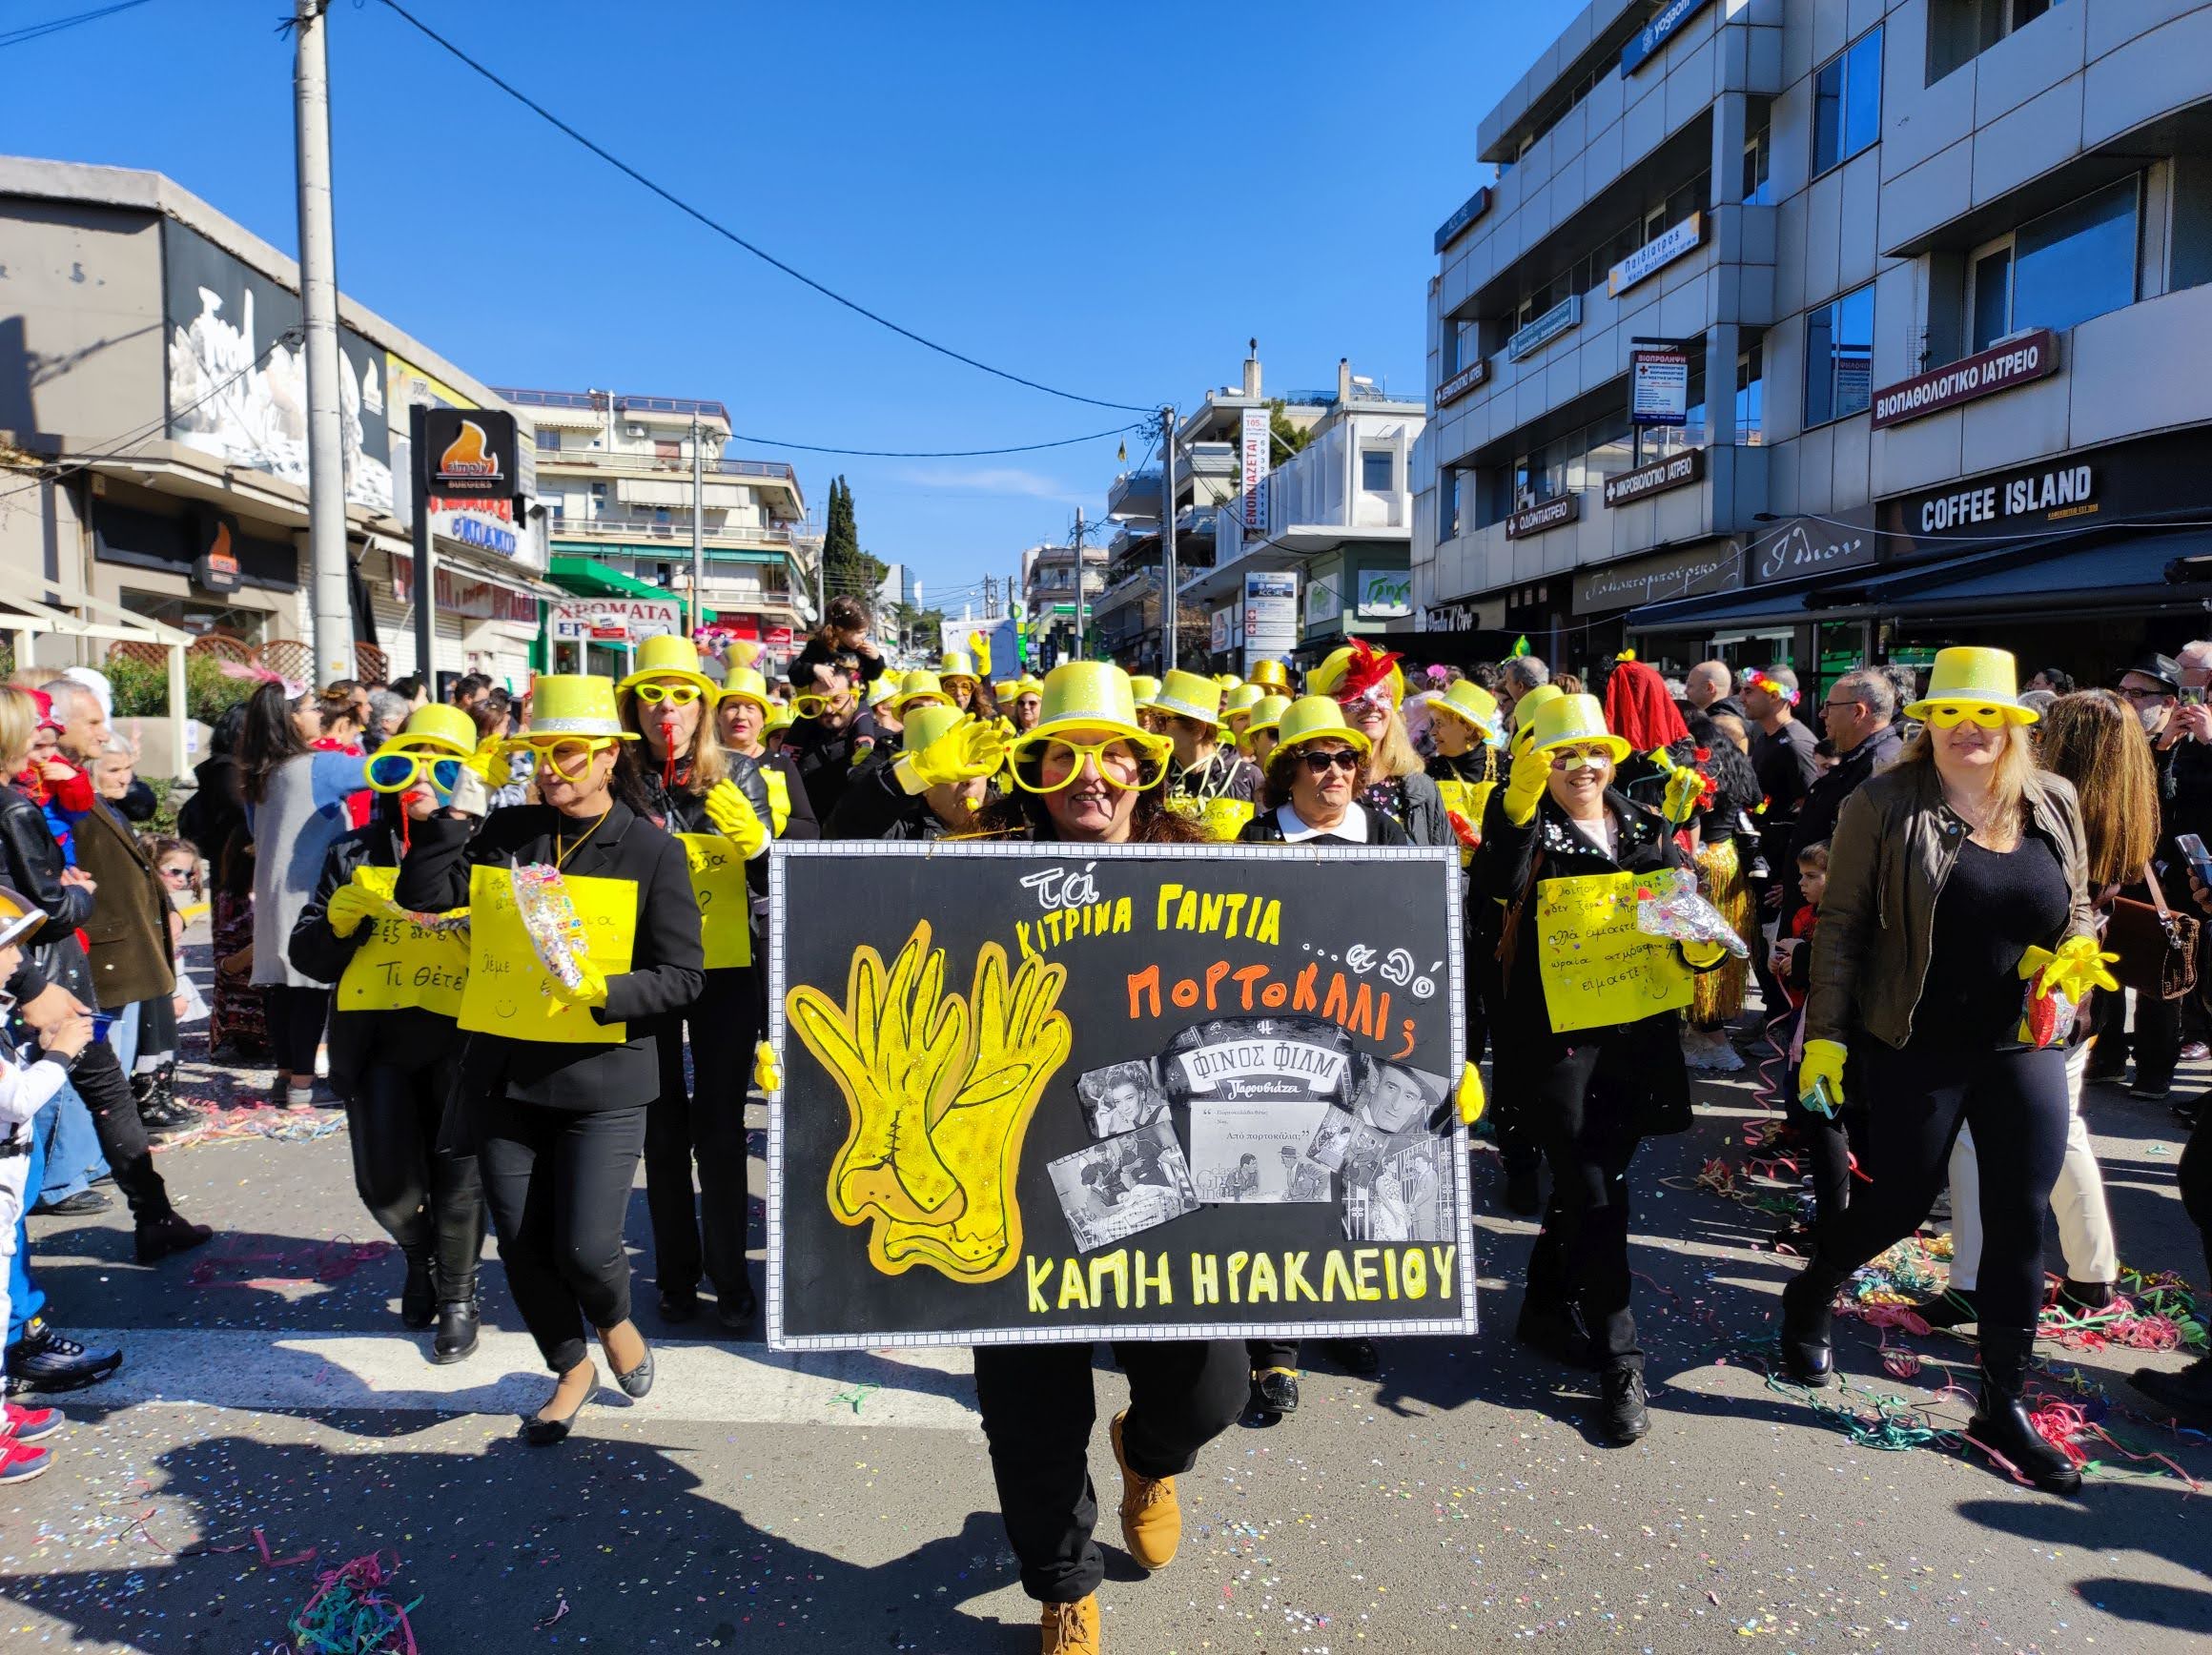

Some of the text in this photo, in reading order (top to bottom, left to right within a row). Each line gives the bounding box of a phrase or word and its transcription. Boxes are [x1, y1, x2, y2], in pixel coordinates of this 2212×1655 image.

[1638, 355, 1687, 363] ΒΙΟΠΡΟΛΗΨΗ
[1876, 346, 2038, 420] ΒΙΟΠΑΘΟΛΟΓΙΚΟ ΙΑΤΡΕΙΟ
[1246, 439, 1257, 525] ΕΝΟΙΚΙΑΖΕΤΑΙ
[1667, 457, 1692, 480] ΙΑΤΡΕΙΟ
[1519, 501, 1567, 531] ΟΔΟΝΤΙΑΤΡΕΙΟ
[1921, 465, 2092, 533] COFFEE ISLAND
[1015, 884, 1280, 960] ΚΙΤΡΙΝΑ ΓΑΝΤΙΑ
[1193, 1042, 1339, 1079] ΦΙΝΟΣ ΦΙΛΜ
[1226, 1132, 1244, 1140] Από
[1027, 1245, 1456, 1314] ΚΑΠΗ ΗΡΑΚΛΕΙΟΥ
